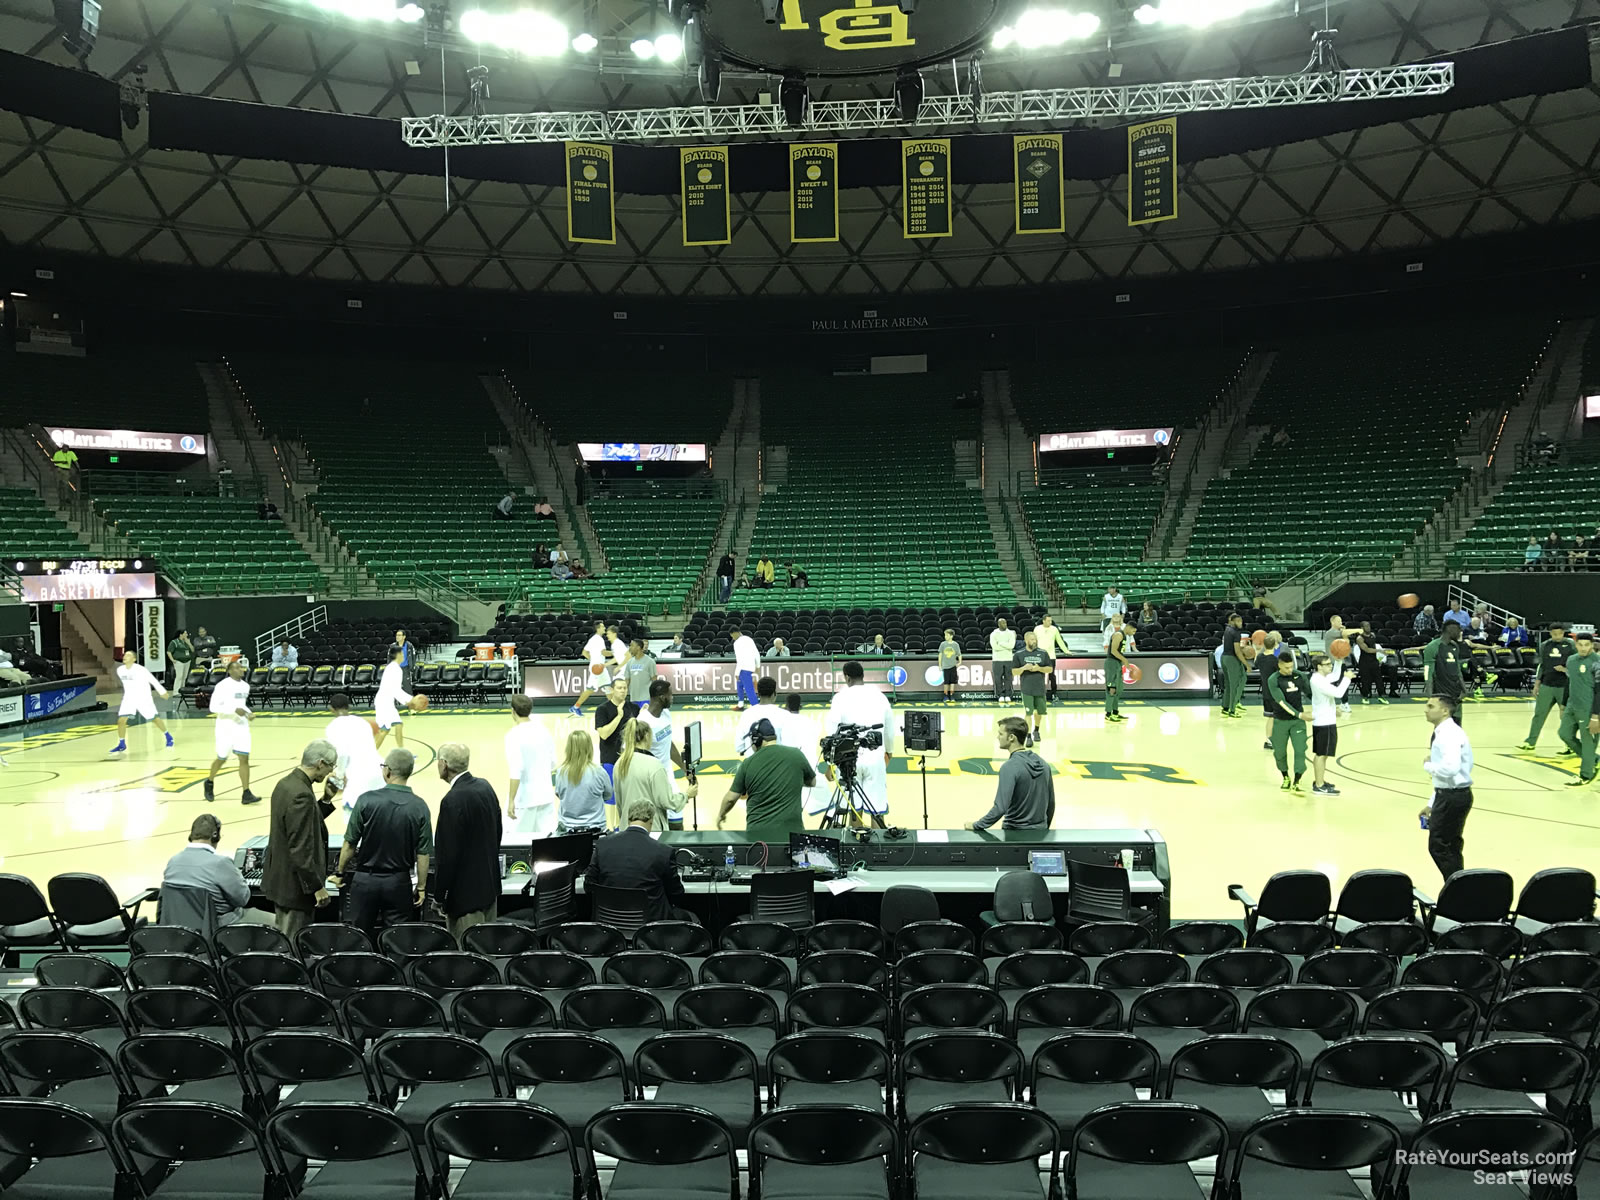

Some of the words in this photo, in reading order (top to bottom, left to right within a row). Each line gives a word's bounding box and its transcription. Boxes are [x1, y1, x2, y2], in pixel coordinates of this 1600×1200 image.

[1131, 124, 1173, 142] BAYLOR
[906, 143, 947, 157] BAYLOR
[1017, 139, 1059, 152] BAYLOR
[1138, 145, 1166, 157] SWC
[569, 146, 609, 162] BAYLOR
[684, 150, 725, 164] BAYLOR
[793, 147, 834, 160] BAYLOR
[1135, 156, 1170, 168] CHAMPIONS
[811, 320, 839, 330] PAUL
[851, 319, 889, 329] MEYER
[891, 317, 929, 328] ARENA
[99, 561, 125, 569] FGCU
[40, 586, 125, 600] BASKETBALL
[148, 606, 160, 660] BEARS
[673, 666, 704, 691] the
